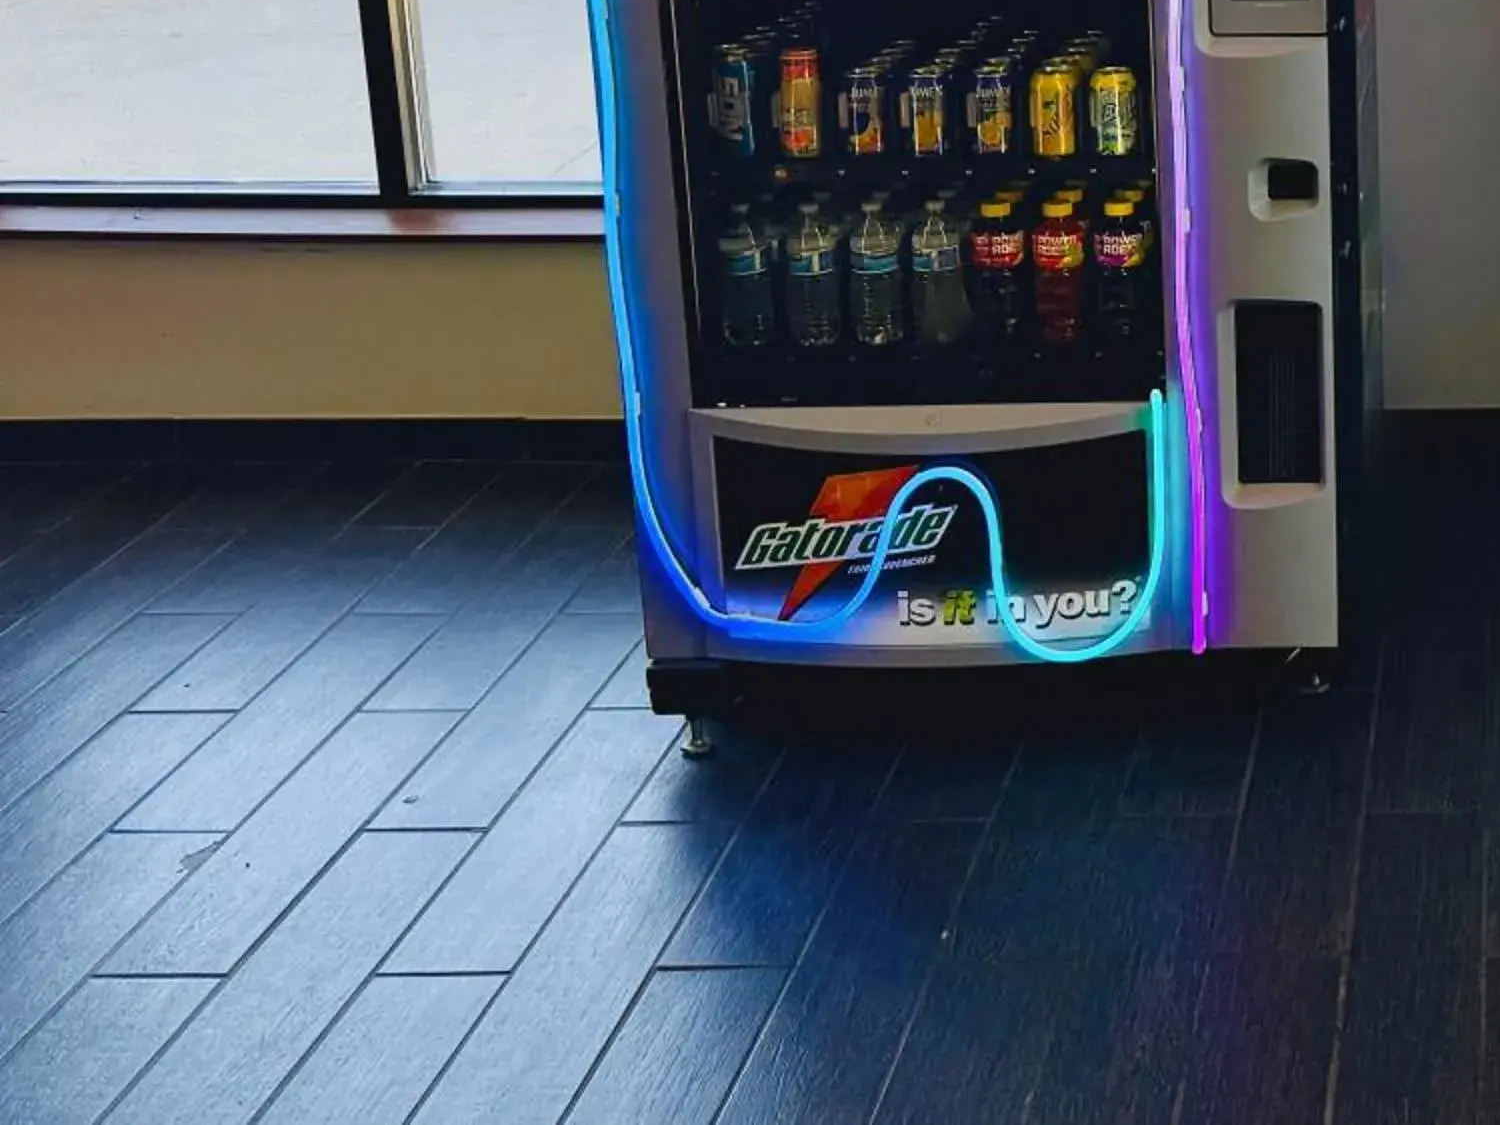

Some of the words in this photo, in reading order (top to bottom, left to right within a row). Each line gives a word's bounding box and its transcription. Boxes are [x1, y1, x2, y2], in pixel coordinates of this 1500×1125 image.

[735, 504, 958, 570] Gatorade
[897, 590, 936, 626] is
[943, 589, 977, 625] it
[985, 588, 1027, 625] in
[1033, 579, 1138, 630] you?
